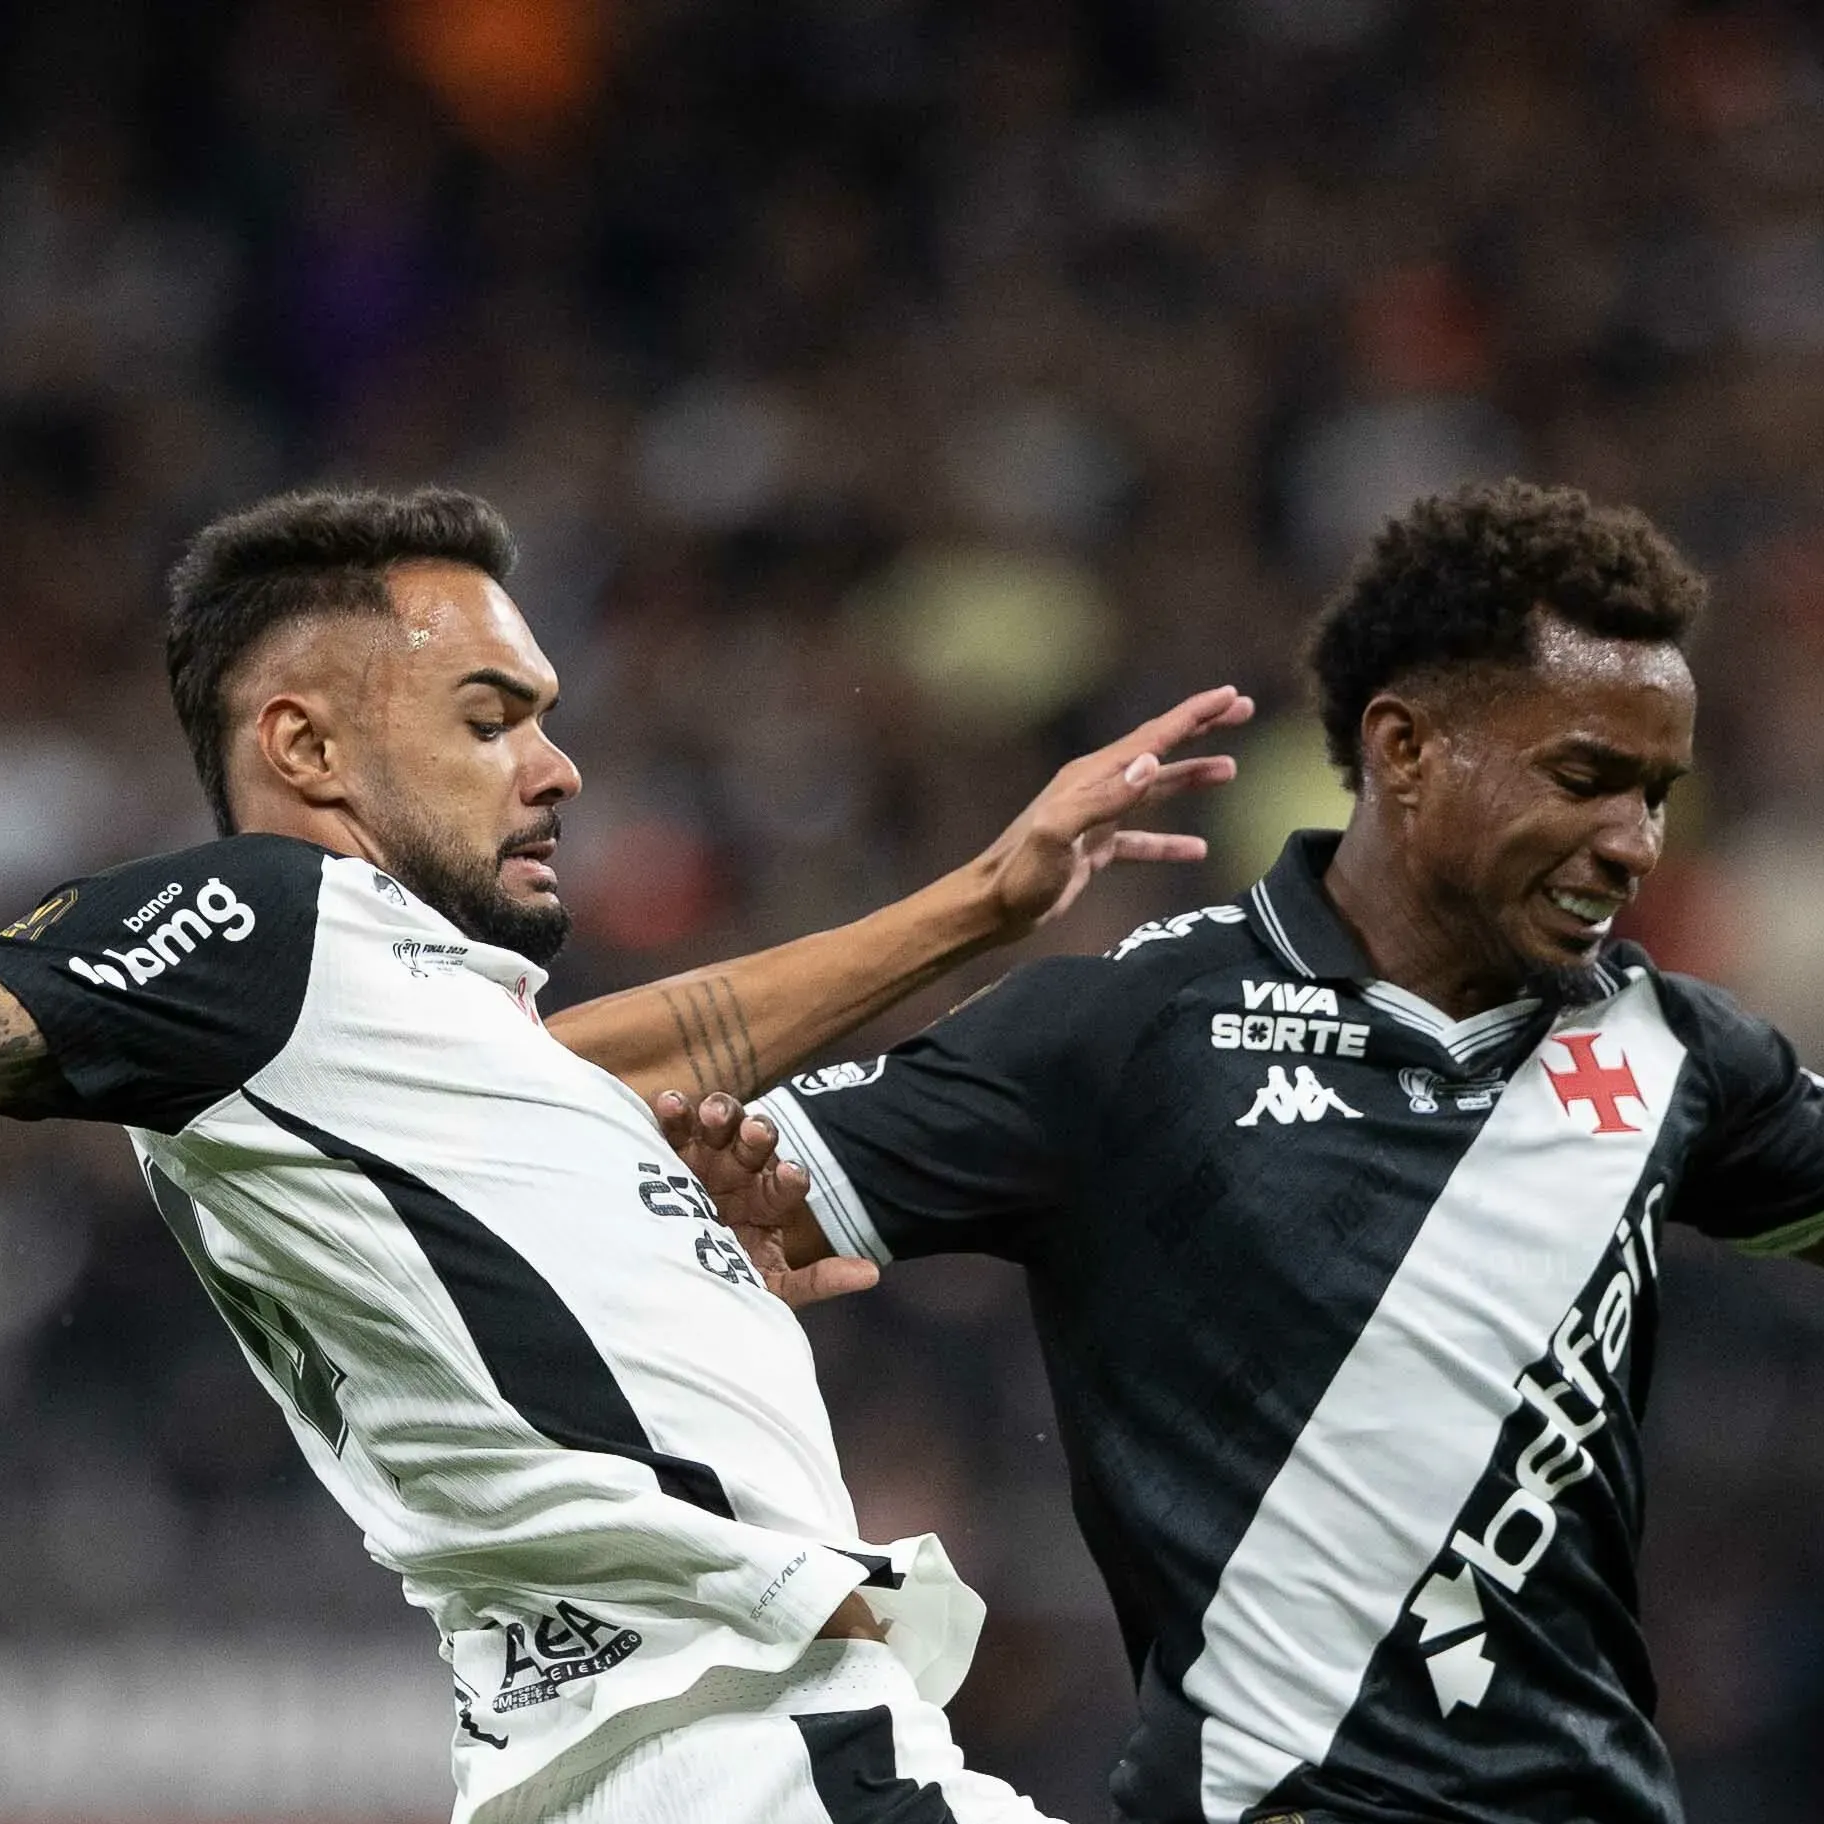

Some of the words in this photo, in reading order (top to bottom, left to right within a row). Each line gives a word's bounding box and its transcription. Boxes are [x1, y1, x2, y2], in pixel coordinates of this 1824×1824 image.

[102, 877, 256, 986] bmg
[122, 881, 183, 933] banco
[1242, 979, 1339, 1016] VIVA
[1211, 1013, 1370, 1059] SORTE
[1450, 1182, 1666, 1595] betfair
[549, 1633, 638, 1682] Elétrico
[497, 1684, 556, 1709] Mate
